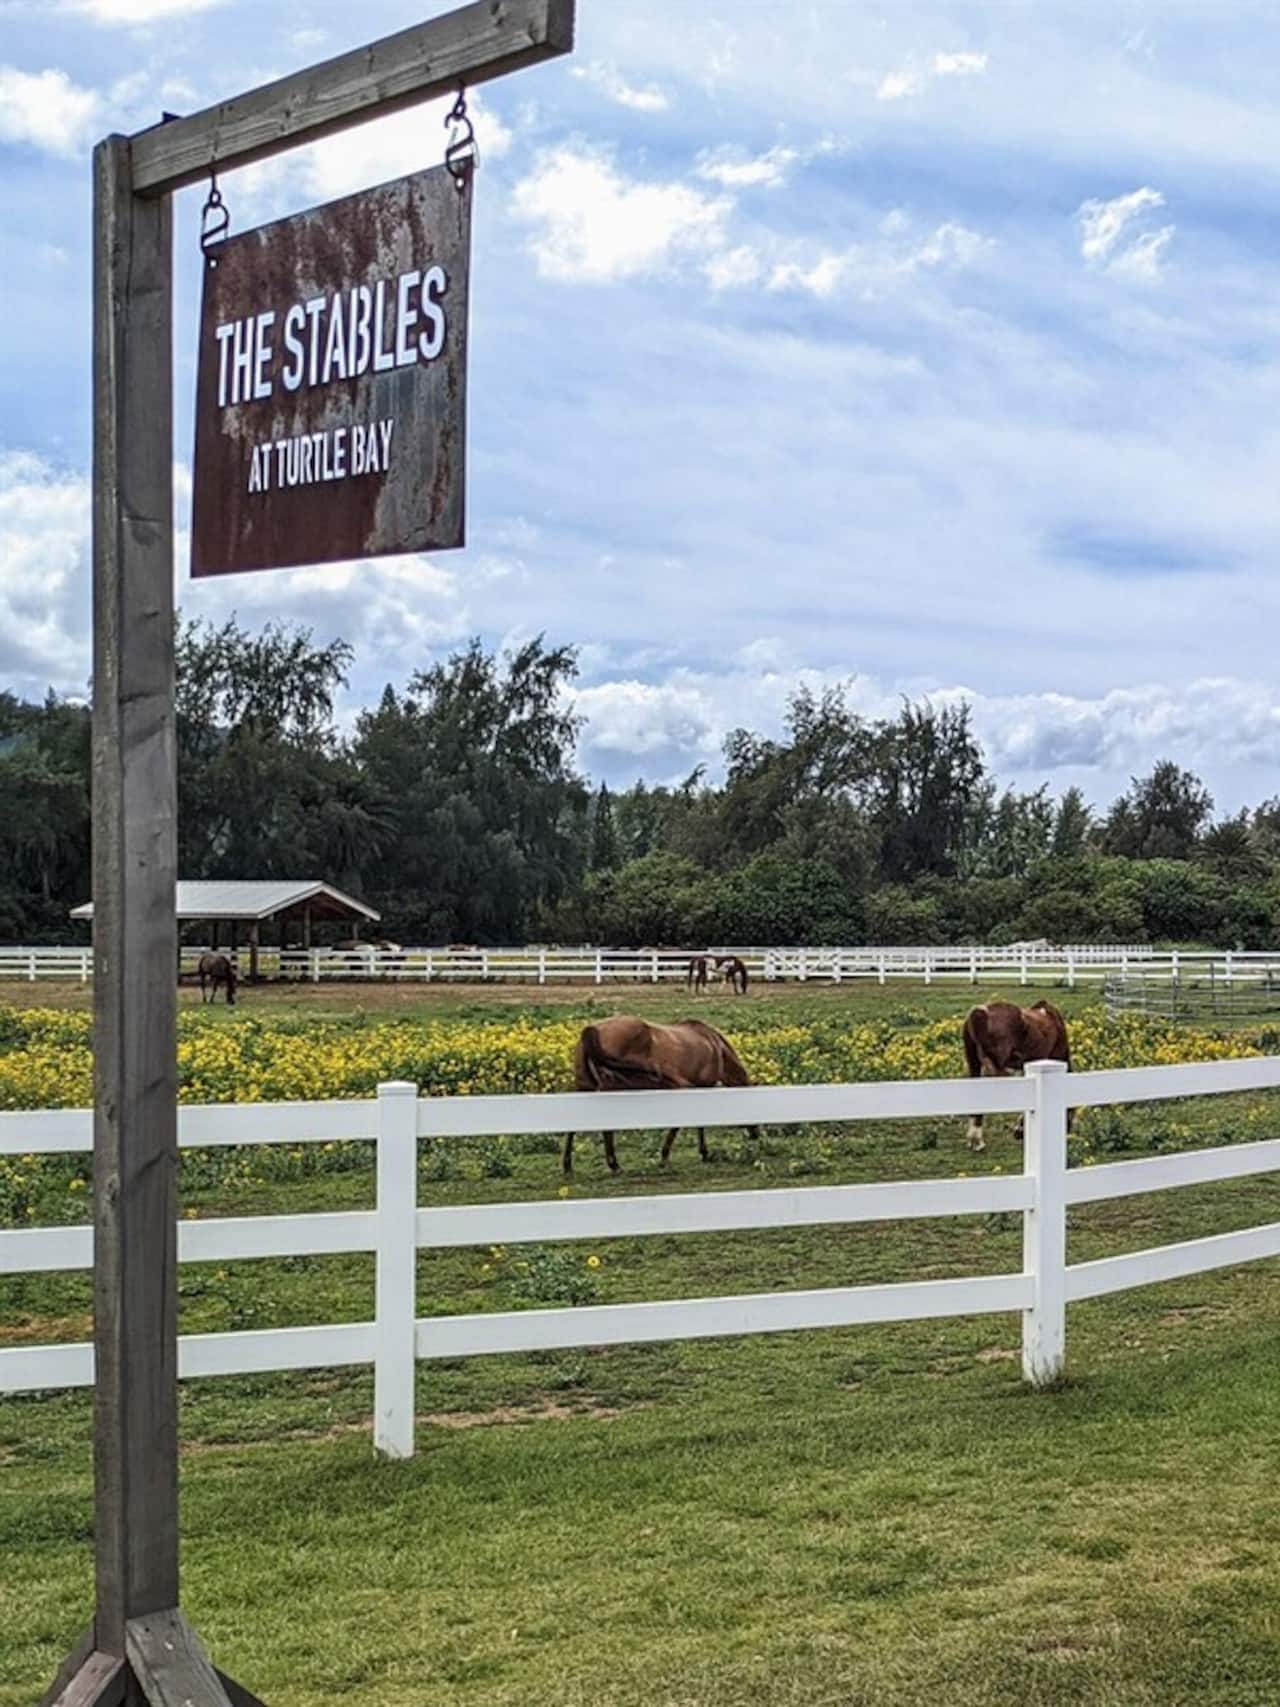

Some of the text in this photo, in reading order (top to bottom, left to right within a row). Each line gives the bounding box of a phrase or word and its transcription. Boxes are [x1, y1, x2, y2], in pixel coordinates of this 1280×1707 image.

[217, 265, 445, 407] THE STABLES
[248, 419, 393, 493] AT TURTLE BAY
